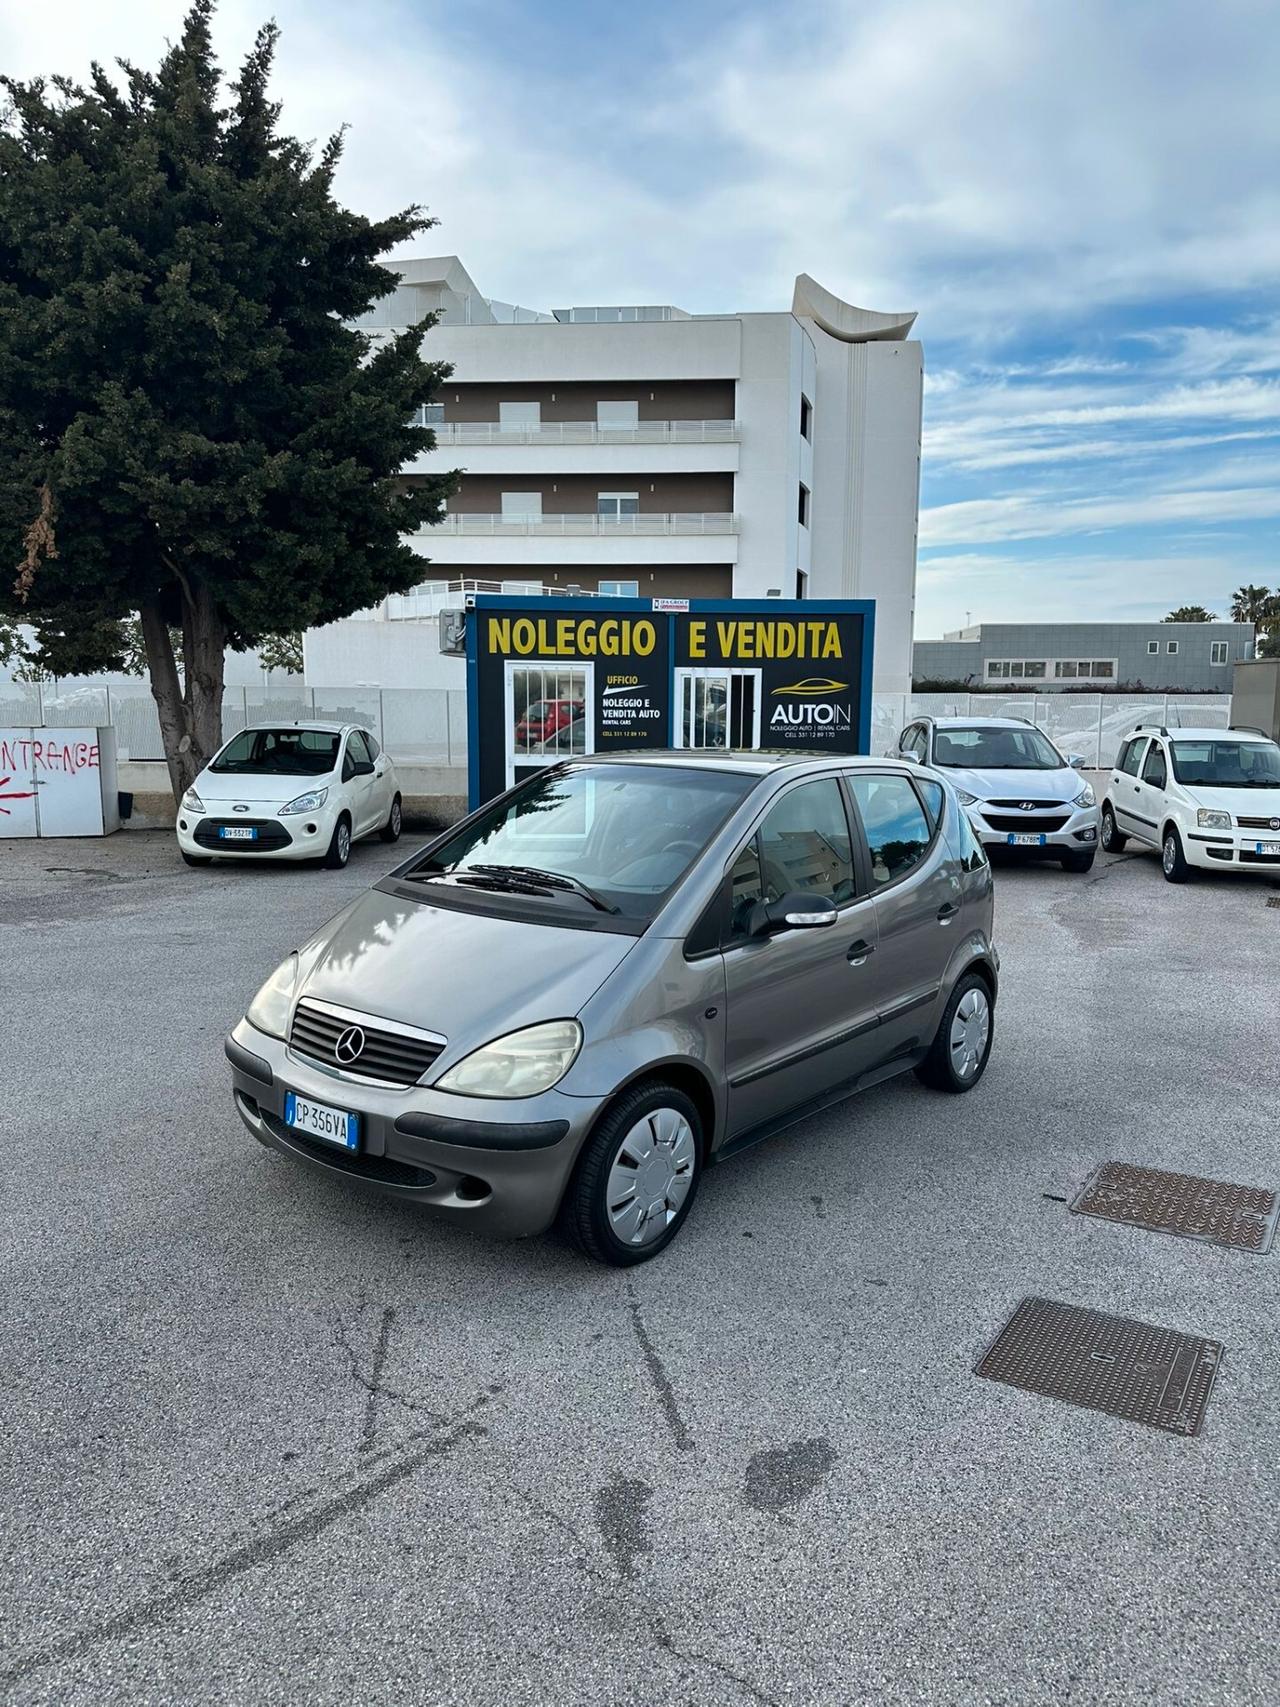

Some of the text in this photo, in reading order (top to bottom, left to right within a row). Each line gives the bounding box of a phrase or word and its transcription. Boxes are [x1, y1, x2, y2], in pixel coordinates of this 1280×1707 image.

[488, 618, 843, 658] NOLEGGIO E VENDITA
[607, 675, 638, 684] UFFICIO
[602, 698, 650, 708] NOLEGGIO E
[602, 710, 660, 718] VENDITA AUTO
[296, 1102, 346, 1140] CP 356VA
